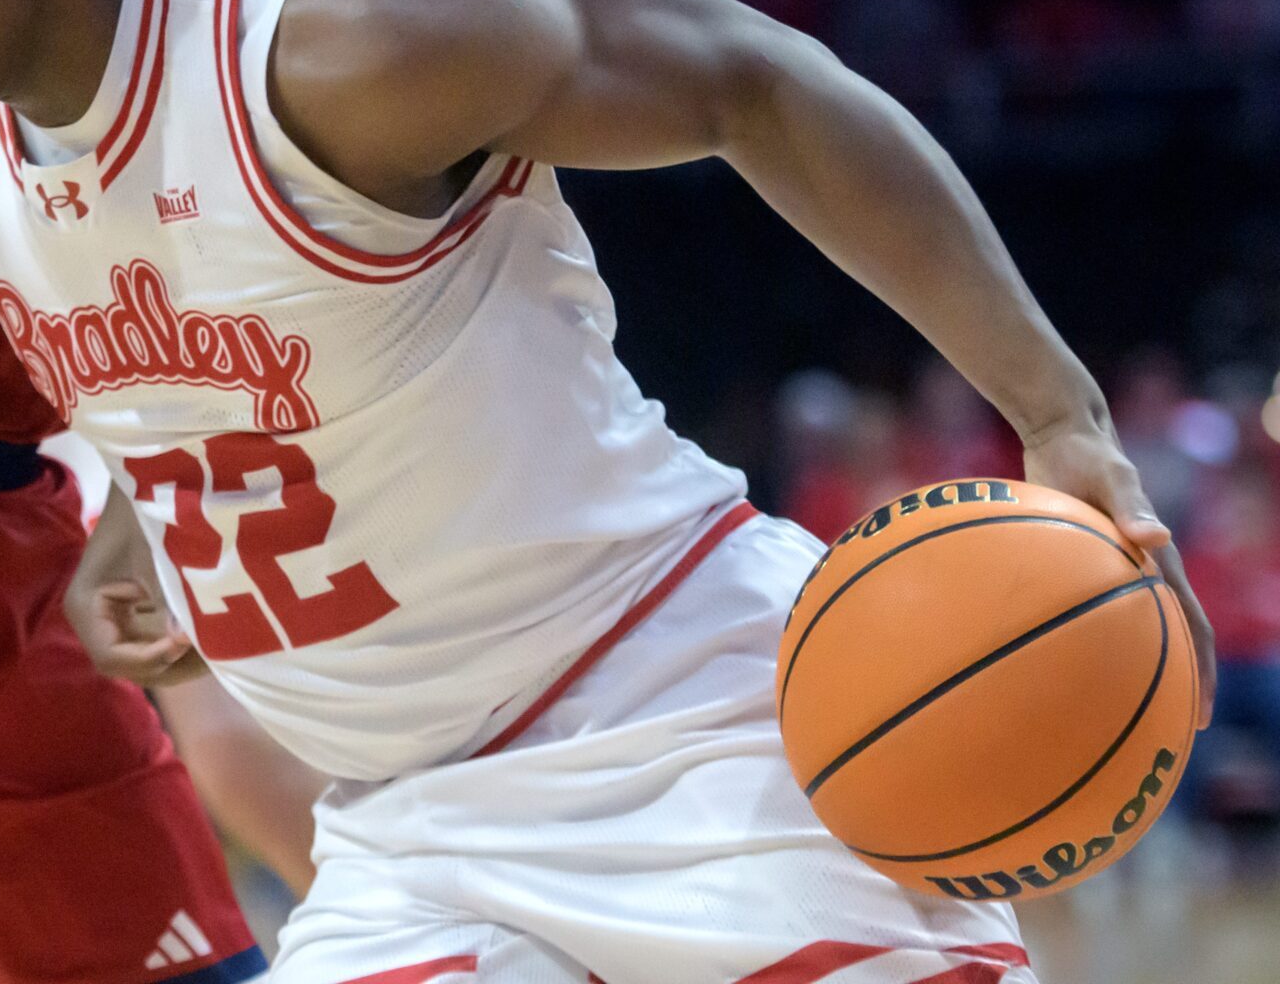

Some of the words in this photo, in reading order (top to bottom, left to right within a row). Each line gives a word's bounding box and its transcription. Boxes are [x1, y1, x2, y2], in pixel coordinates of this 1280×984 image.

[153, 183, 198, 218] VALLEY
[123, 430, 400, 661] 22
[924, 747, 1177, 900] Wilson
